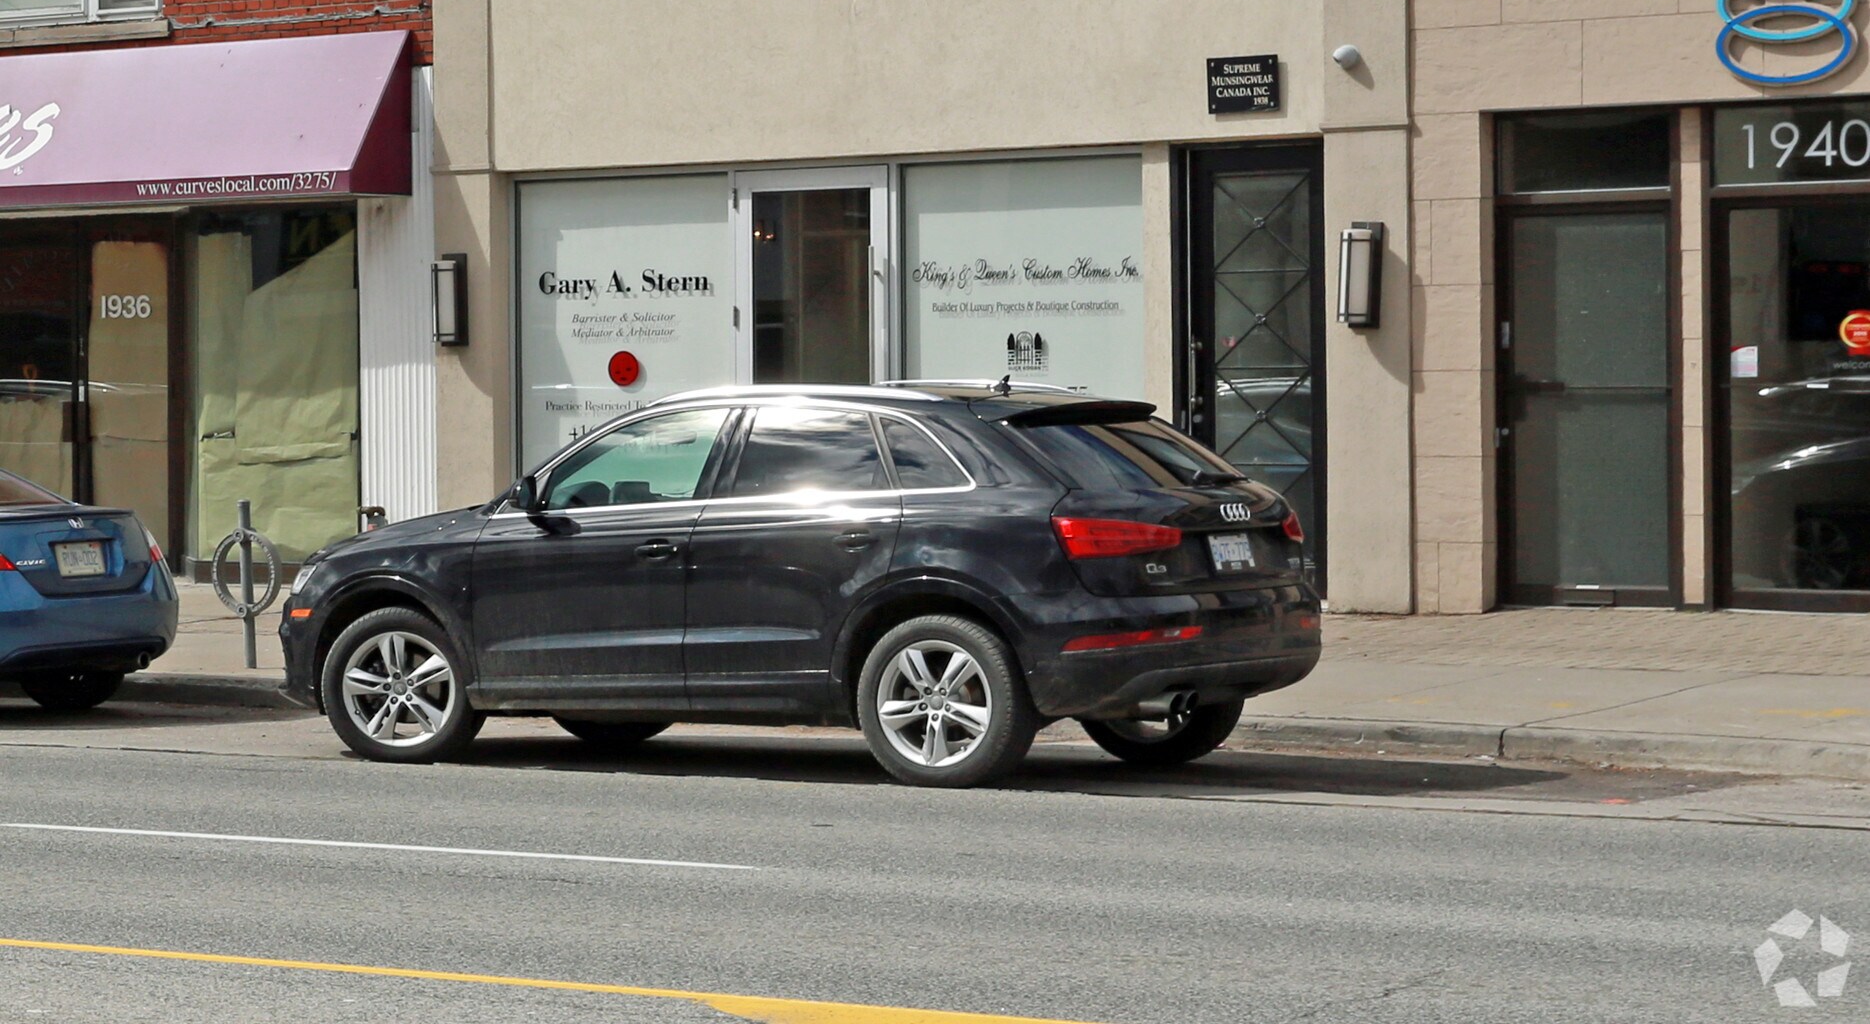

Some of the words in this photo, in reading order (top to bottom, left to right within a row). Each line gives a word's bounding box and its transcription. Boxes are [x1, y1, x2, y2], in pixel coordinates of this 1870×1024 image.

[1223, 63, 1261, 74] SUPREME
[1216, 87, 1252, 98] CANADA
[1742, 119, 1870, 169] 1940
[136, 172, 337, 196] www.curveslocal.com/3275/
[1022, 258, 1063, 280] Custom
[1068, 257, 1111, 279] Homes
[539, 271, 597, 301] Gary
[606, 269, 631, 293] A.
[641, 268, 710, 293] Stern
[100, 294, 152, 320] 1936
[932, 302, 958, 313] Builder
[970, 302, 994, 314] Luxury
[996, 301, 1025, 314] Projects
[1035, 301, 1070, 313] Boutique
[1070, 299, 1119, 311] Construction
[572, 313, 617, 324] Barrister
[619, 312, 629, 323] &
[632, 311, 676, 322] Solicitor
[571, 327, 613, 339] Mediator
[616, 327, 625, 337] &
[627, 326, 675, 337] Arbitrator
[545, 400, 582, 411] Practice
[585, 400, 631, 411] Restricted
[16, 558, 46, 567] CIVIC
